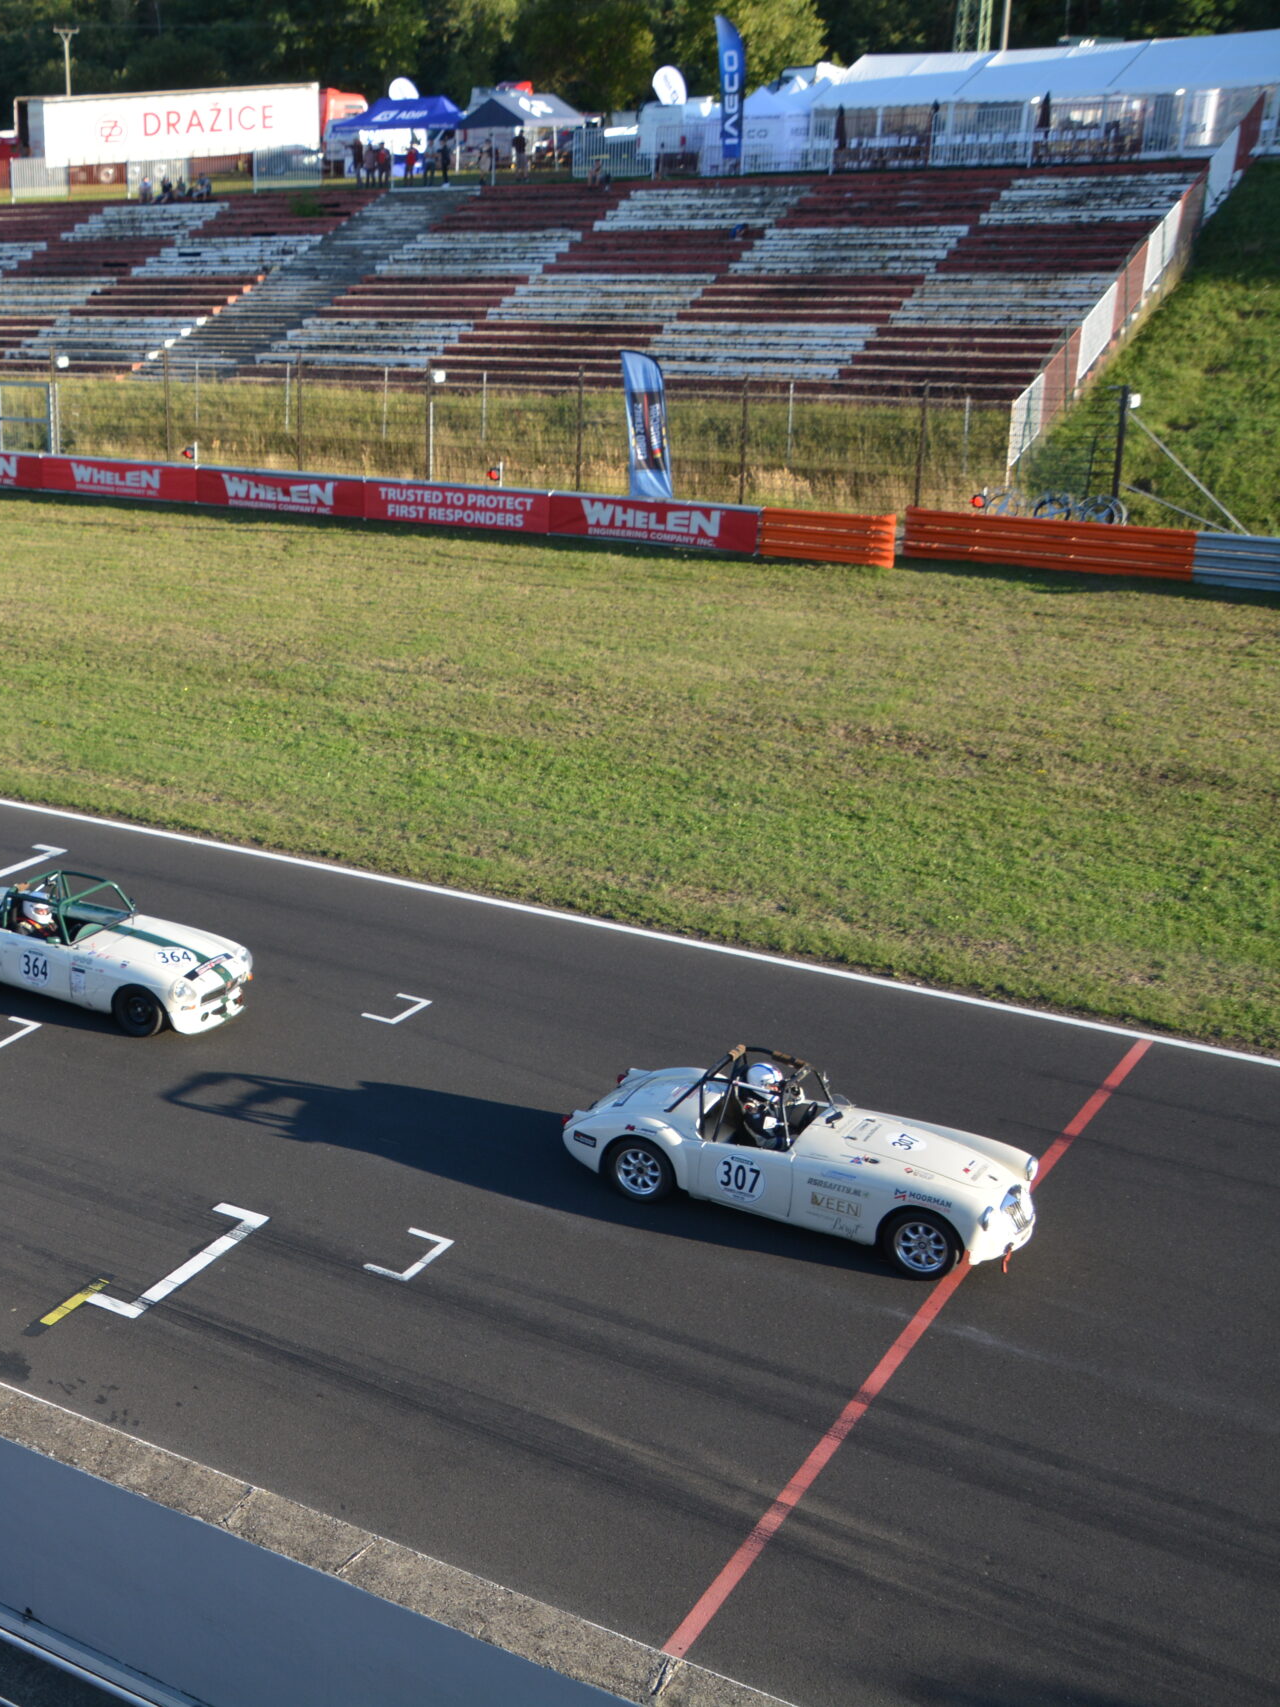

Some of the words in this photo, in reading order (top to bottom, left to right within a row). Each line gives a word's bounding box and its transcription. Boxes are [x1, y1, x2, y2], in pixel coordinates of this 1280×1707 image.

[143, 102, 273, 137] DRAŽICE
[70, 462, 161, 489] WHELEN
[221, 473, 335, 506] WHELEN
[379, 486, 443, 504] TRUSTED
[445, 491, 465, 506] TO
[467, 494, 534, 511] PROTECT
[387, 503, 426, 519] FIRST
[428, 508, 524, 527] RESPONDERS
[580, 498, 721, 538] WHELEN
[588, 527, 648, 540] ENGINEERING
[650, 531, 696, 545] COMPANY
[697, 536, 717, 548] INC.
[23, 953, 48, 981] 364
[157, 950, 192, 964] 364
[892, 1132, 920, 1151] 307
[720, 1160, 761, 1193] 307
[811, 1192, 859, 1217] VEEN
[909, 1191, 953, 1209] MOORMAN
